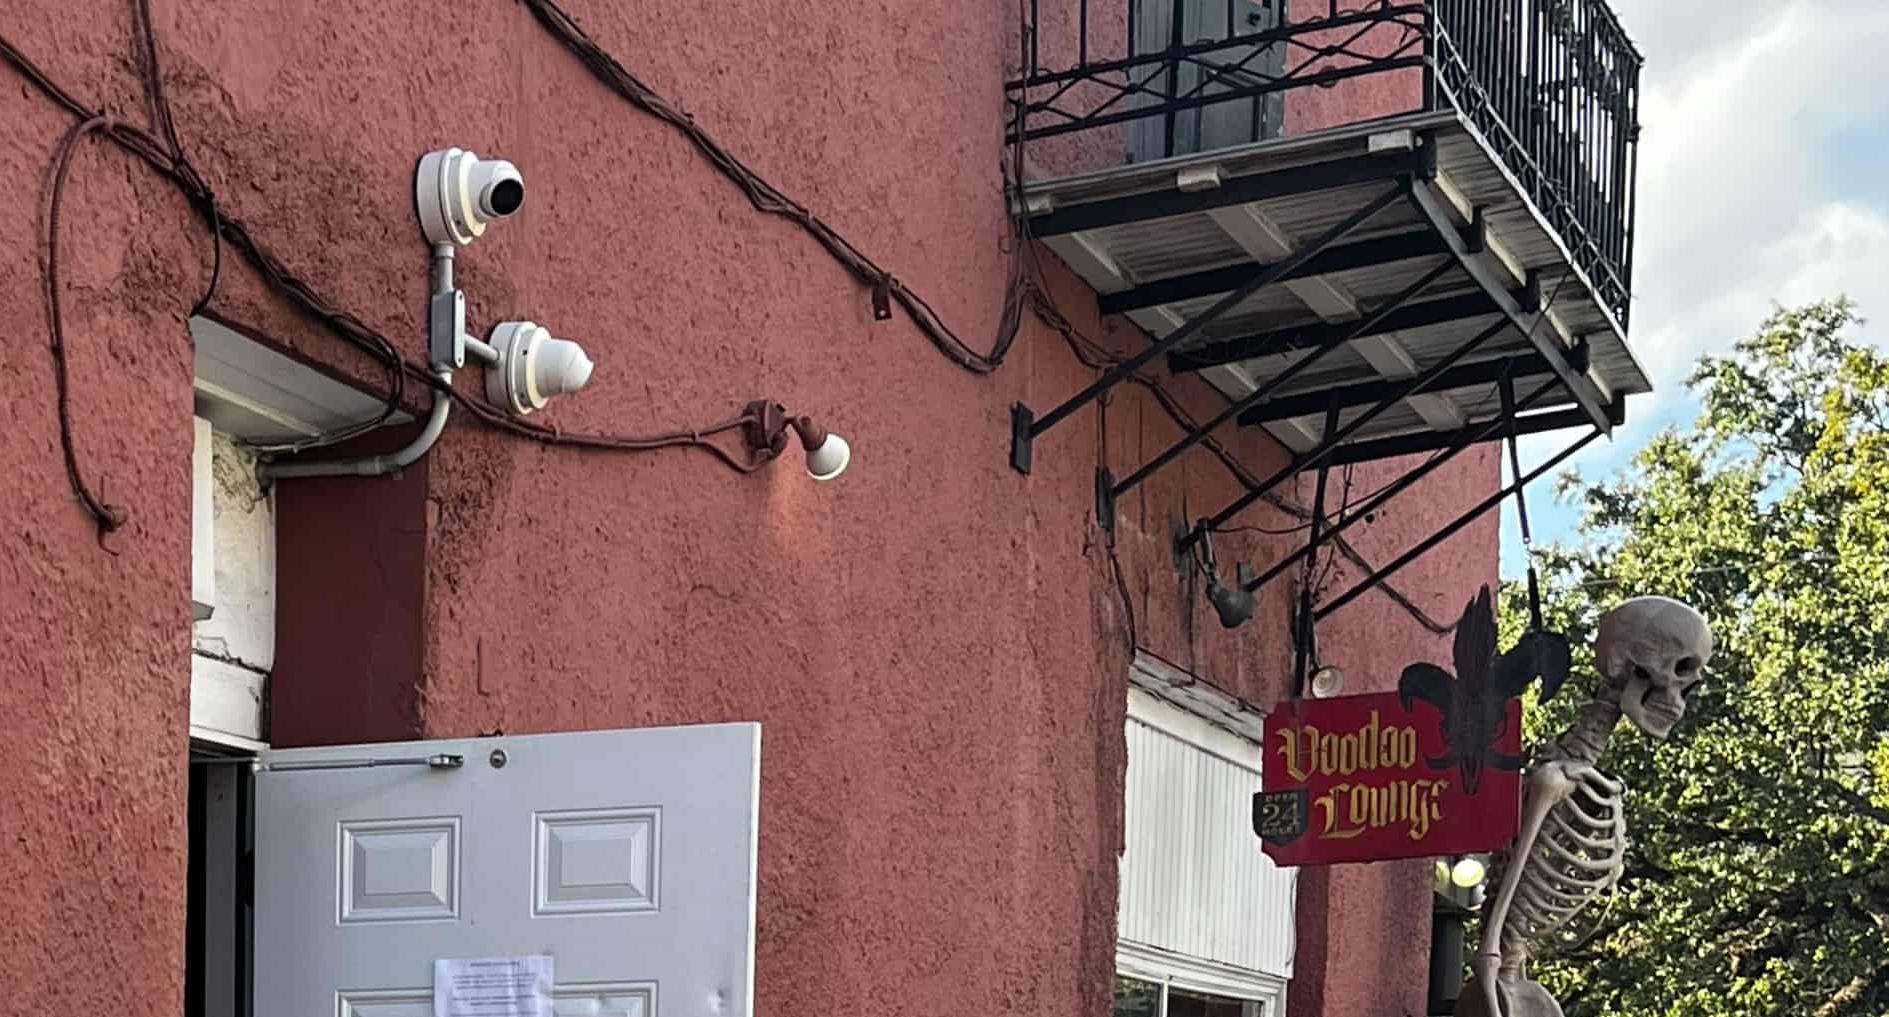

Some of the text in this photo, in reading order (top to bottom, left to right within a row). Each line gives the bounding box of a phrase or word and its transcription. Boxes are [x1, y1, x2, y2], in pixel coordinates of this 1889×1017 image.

[1275, 710, 1417, 783] Voodoo
[1262, 801, 1301, 827] 24
[1314, 779, 1449, 840] Lounge
